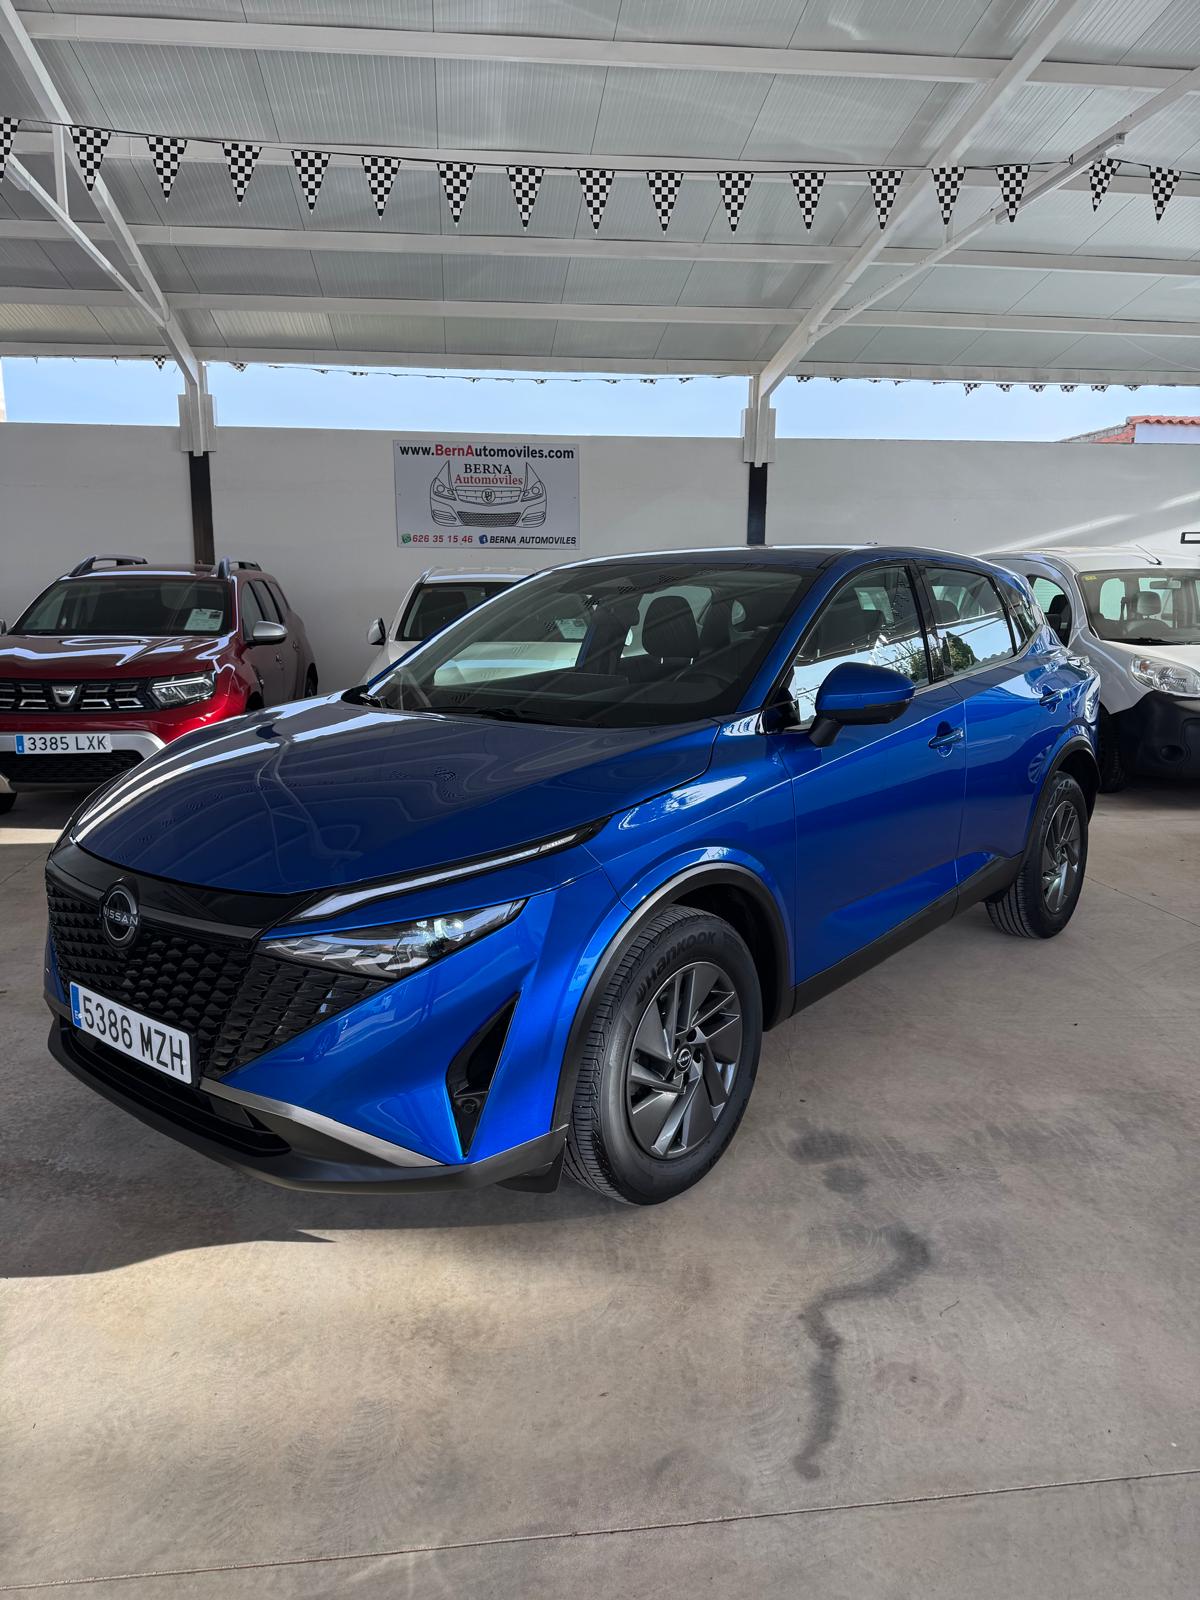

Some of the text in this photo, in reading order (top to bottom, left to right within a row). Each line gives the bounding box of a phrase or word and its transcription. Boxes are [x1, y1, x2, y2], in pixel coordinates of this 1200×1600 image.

[400, 444, 574, 459] www.BernAutomoviles.com
[464, 463, 512, 475] BERNA
[454, 473, 523, 486] Automóviles
[412, 534, 473, 544] 626 35 15 46
[490, 535, 577, 545] BERNA AUTOMOVILES
[28, 736, 70, 751] 3385
[75, 735, 107, 751] LXK
[103, 907, 139, 927] NISSAN
[82, 996, 186, 1076] 5386 MZH
